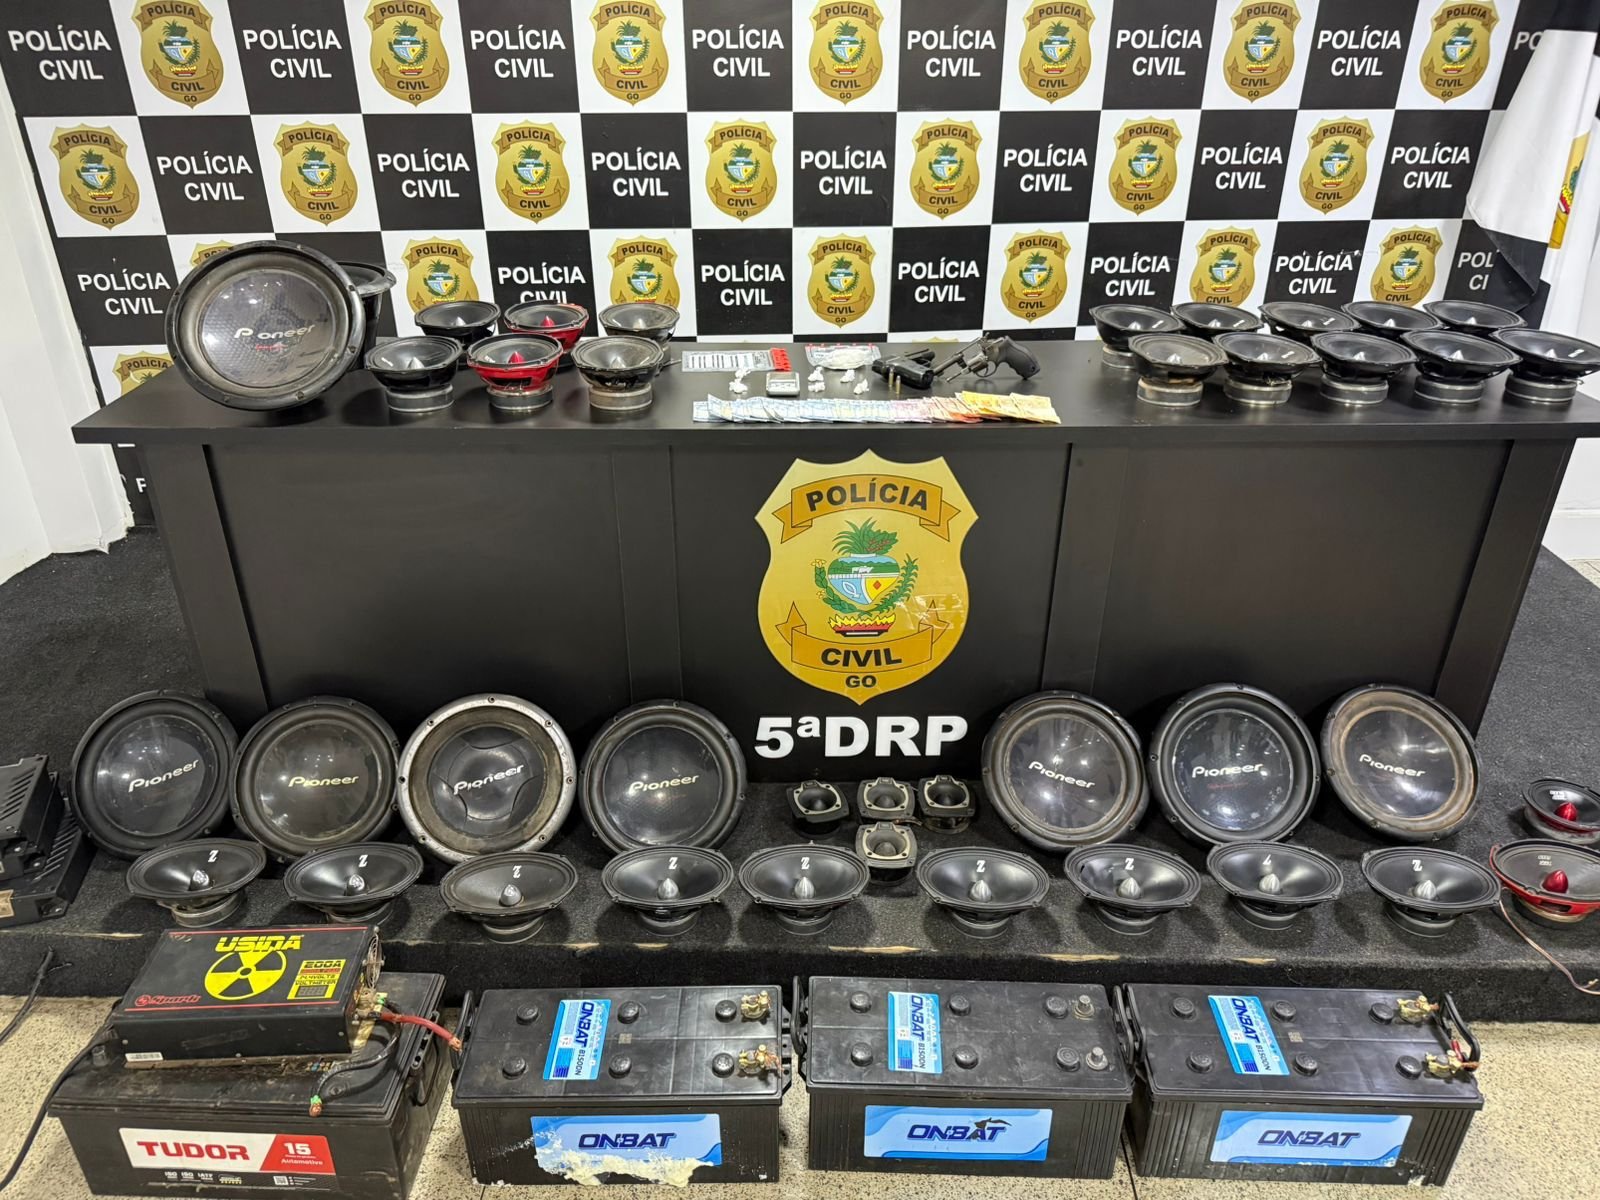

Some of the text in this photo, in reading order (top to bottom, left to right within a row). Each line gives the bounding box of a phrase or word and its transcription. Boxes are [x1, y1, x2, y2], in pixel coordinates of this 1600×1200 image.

[147, 1, 196, 17] POLÍCIA
[380, 2, 426, 17] POLÍCIA
[605, 3, 650, 17] POLÍCIA
[825, 2, 868, 18] POLÍCIA
[1039, 2, 1081, 18] POLÍCIA
[1247, 3, 1287, 18] POLÍCIA
[1447, 5, 1487, 19] POLÍCIA
[8, 25, 111, 51] POLÍCIA
[243, 25, 342, 49] POLÍCIA
[471, 25, 565, 50] POLÍCIA
[693, 24, 784, 49] POLÍCIA
[908, 25, 996, 50] POLÍCIA
[1117, 25, 1202, 48] POLÍCIA
[1318, 25, 1401, 49] POLÍCIA
[40, 60, 103, 80] CIVIL
[271, 59, 331, 78] CIVIL
[495, 59, 553, 78] CIVIL
[713, 57, 770, 77] CIVIL
[926, 58, 980, 77] CIVIL
[1133, 57, 1185, 75] CIVIL
[1331, 57, 1382, 76] CIVIL
[171, 82, 204, 91] CIVIL
[397, 81, 429, 90] CIVIL
[617, 80, 647, 89] CIVIL
[831, 79, 860, 88] CIVIL
[1039, 79, 1068, 88] CIVIL
[1241, 78, 1269, 86] CIVIL
[1436, 79, 1463, 87] CIVIL
[288, 129, 333, 143] POLÍCIA
[507, 128, 550, 142] POLÍCIA
[720, 126, 762, 140] POLÍCIA
[927, 125, 968, 139] POLÍCIA
[1129, 123, 1168, 137] POLÍCIA
[1323, 123, 1361, 137] POLÍCIA
[64, 131, 111, 147] POLÍCIA
[378, 148, 470, 172] POLÍCIA
[592, 147, 681, 170] POLÍCIA
[801, 146, 886, 169] POLÍCIA
[1004, 144, 1087, 167] POLÍCIA
[1201, 142, 1282, 164] POLÍCIA
[1391, 143, 1469, 164] POLÍCIA
[157, 151, 253, 174] POLÍCIA
[402, 180, 459, 197] CIVIL
[613, 178, 668, 196] CIVIL
[819, 177, 872, 194] CIVIL
[1020, 174, 1072, 192] CIVIL
[1216, 172, 1265, 189] CIVIL
[1404, 172, 1452, 188] CIVIL
[185, 183, 244, 201] CIVIL
[929, 196, 957, 204] CIVIL
[1127, 193, 1154, 201] CIVIL
[1316, 192, 1342, 200] CIVIL
[89, 206, 121, 214] CIVIL
[308, 202, 339, 210] CIVIL
[520, 200, 550, 208] CIVIL
[728, 198, 756, 206] CIVIL
[822, 240, 862, 253] POLÍCIA
[1019, 236, 1057, 249] POLÍCIA
[1210, 232, 1248, 245] POLÍCIA
[1393, 232, 1431, 245] POLÍCIA
[416, 244, 458, 257] POLÍCIA
[622, 242, 663, 256] POLÍCIA
[899, 257, 979, 279] POLÍCIA
[1091, 252, 1170, 274] POLÍCIA
[1276, 251, 1352, 272] POLÍCIA
[498, 262, 585, 284] POLÍCIA
[702, 260, 785, 282] POLÍCIA
[78, 269, 170, 291] POLÍCIA
[1106, 280, 1155, 296] CIVIL
[1289, 278, 1336, 294] CIVIL
[721, 289, 772, 305] CIVIL
[915, 285, 965, 302] CIVIL
[1206, 295, 1232, 304] CIVIL
[105, 298, 163, 315] CIVIL
[827, 306, 855, 314] CIVIL
[1019, 301, 1045, 309] CIVIL
[234, 325, 315, 338] Poneer
[127, 359, 169, 370] POLÍCIA
[806, 477, 927, 512] POLÍCIA
[822, 648, 901, 667] CIVIL
[846, 675, 876, 688] GO
[1191, 763, 1263, 778] Pioneer
[1359, 754, 1426, 777] Pioneer
[128, 759, 199, 793] Pioneer
[288, 775, 359, 787] Pioneer
[453, 764, 524, 795] Pioneer
[1028, 761, 1095, 789] Pioneer
[628, 775, 699, 794] Pioneer
[215, 935, 301, 952] USINA
[575, 1002, 595, 1048] ONBAT
[911, 995, 925, 1041] ONBAT
[1232, 998, 1260, 1044] ONBAT
[578, 1132, 676, 1149] ONBAT
[907, 1124, 1007, 1142] ONBAT
[1258, 1130, 1361, 1148] ONBAT
[136, 1141, 250, 1160] TUDOR
[284, 1142, 311, 1155] 15
[281, 1158, 323, 1166] Automotive
